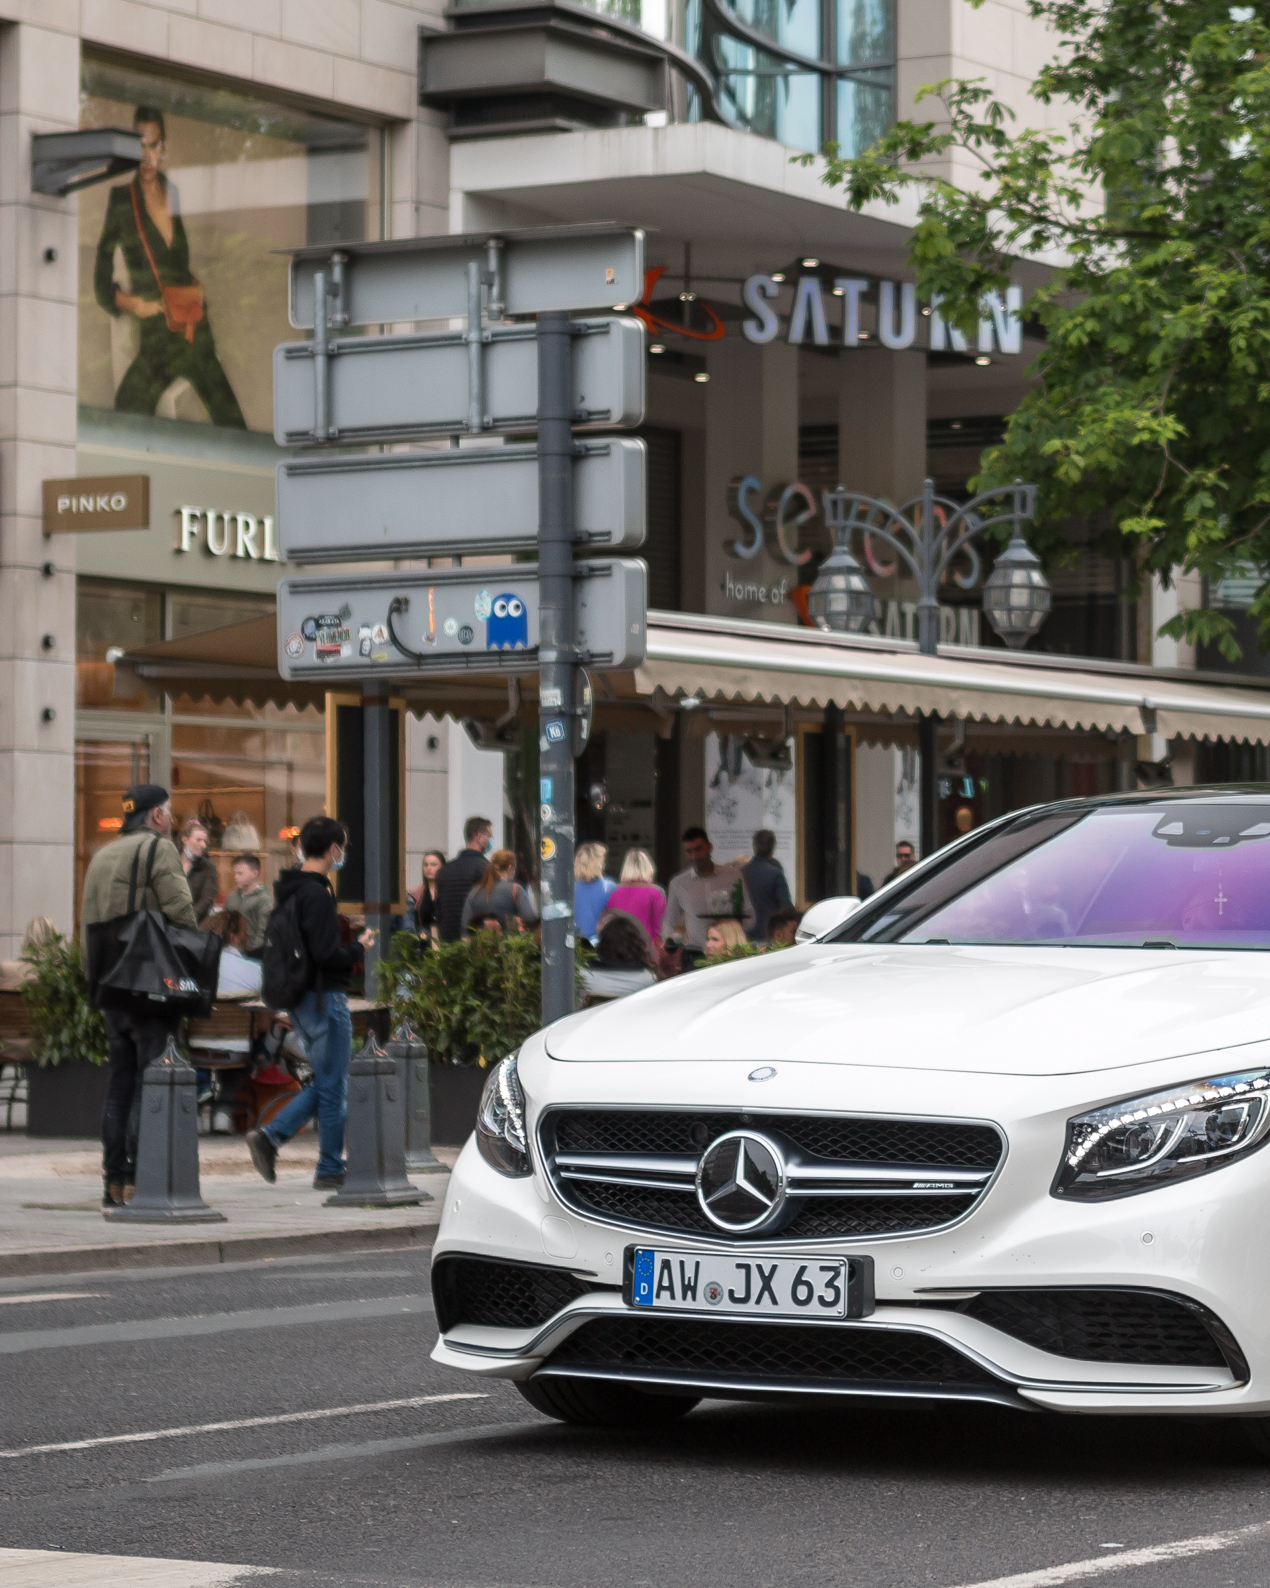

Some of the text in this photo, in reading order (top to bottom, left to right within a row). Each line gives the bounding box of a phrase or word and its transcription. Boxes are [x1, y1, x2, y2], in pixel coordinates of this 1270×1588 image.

[743, 274, 1022, 353] SATURN
[58, 493, 127, 514] PINKO
[726, 572, 787, 605] home of
[868, 598, 980, 647] ATRN
[179, 979, 199, 993] SAT
[640, 1282, 648, 1295] D
[655, 1258, 841, 1308] AW JX 63
